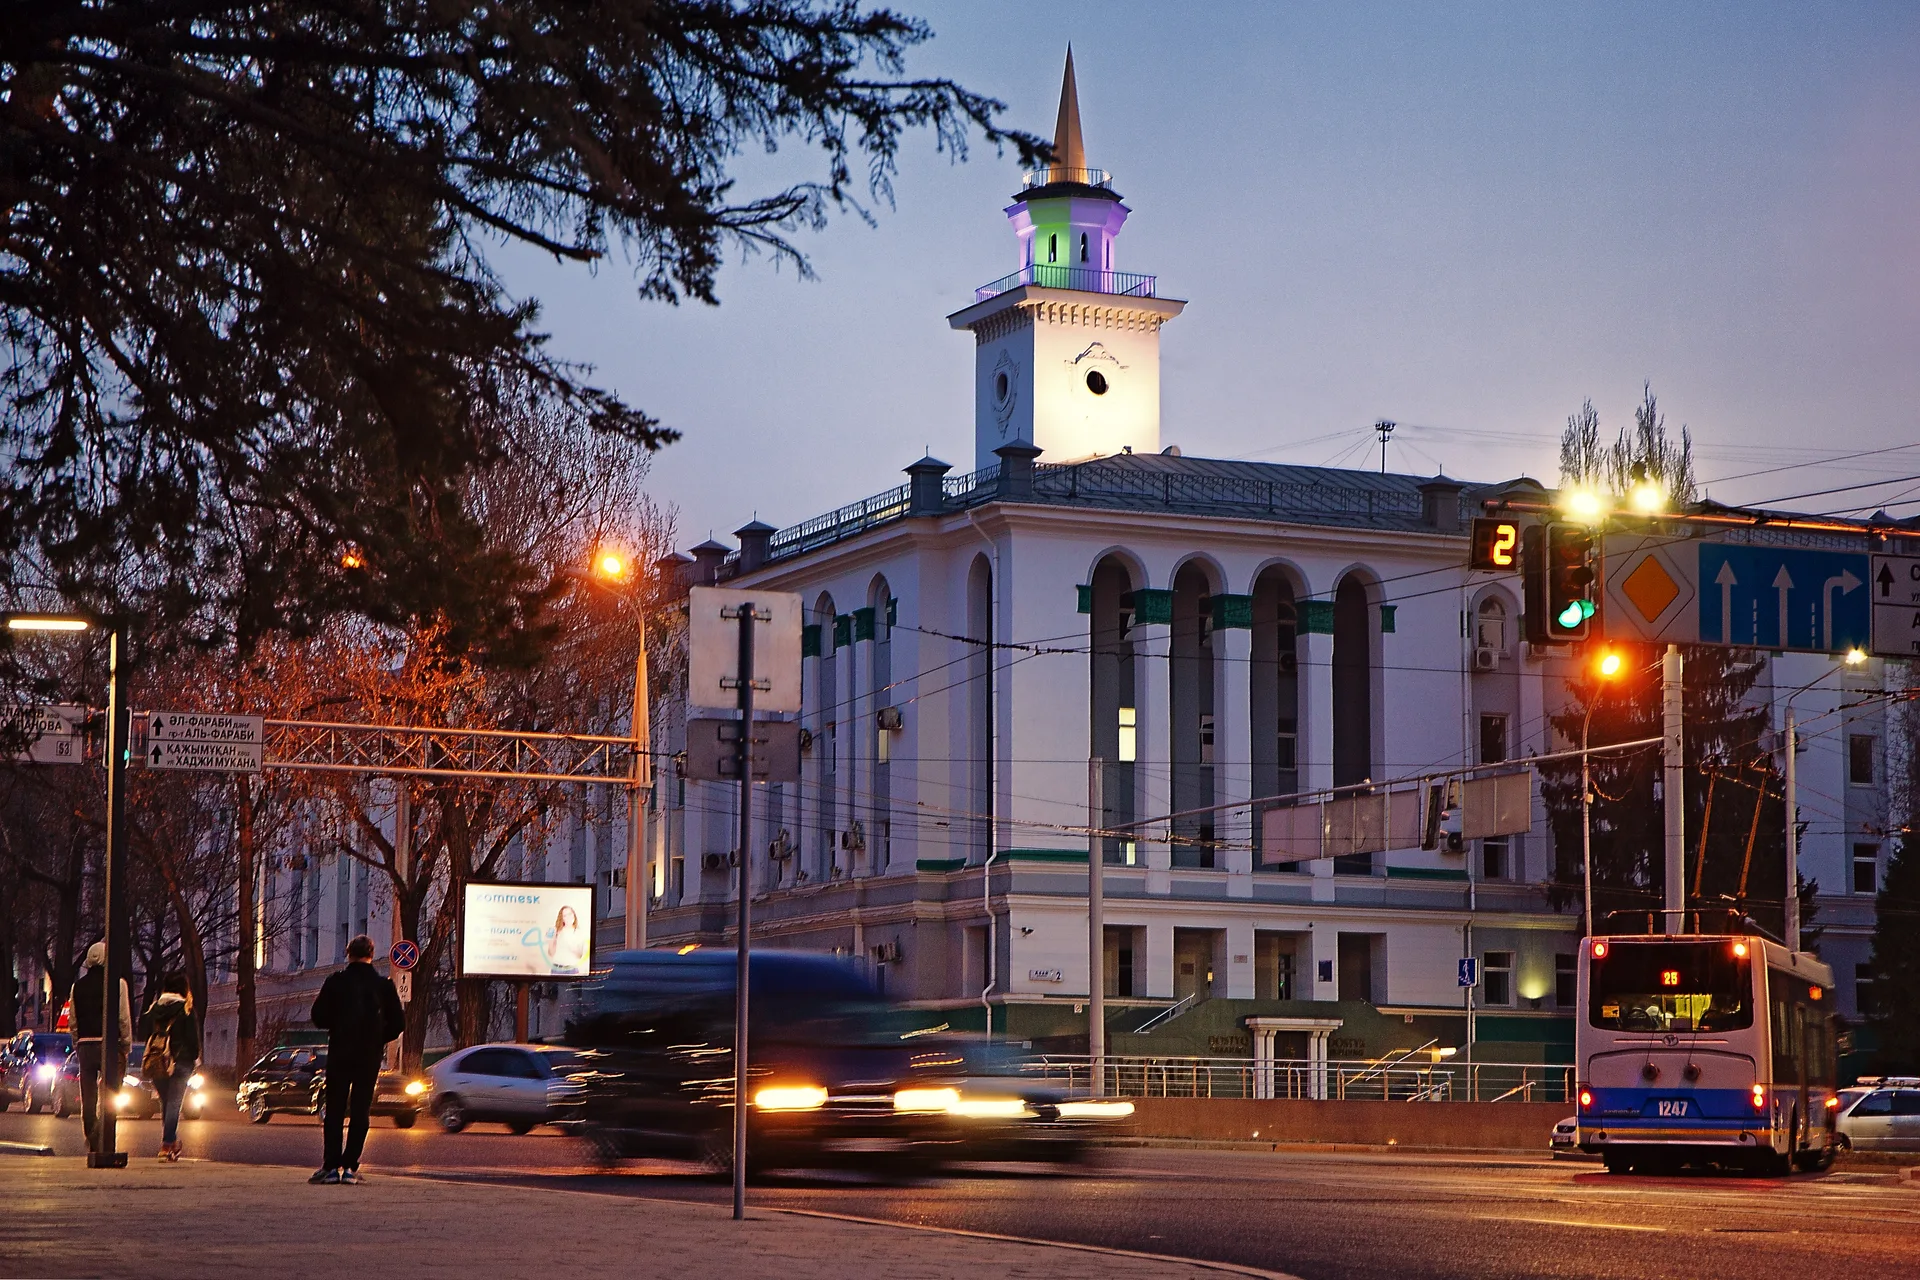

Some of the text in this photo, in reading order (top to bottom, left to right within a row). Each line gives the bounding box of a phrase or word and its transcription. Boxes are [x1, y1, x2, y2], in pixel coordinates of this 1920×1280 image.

[1494, 525, 1516, 565] 2
[169, 715, 233, 729] ӘЛ-ФАРАБИ
[184, 728, 255, 741] АЛЬ-ФАРАБИ
[399, 985, 409, 993] 30
[1658, 1101, 1688, 1117] 1247
